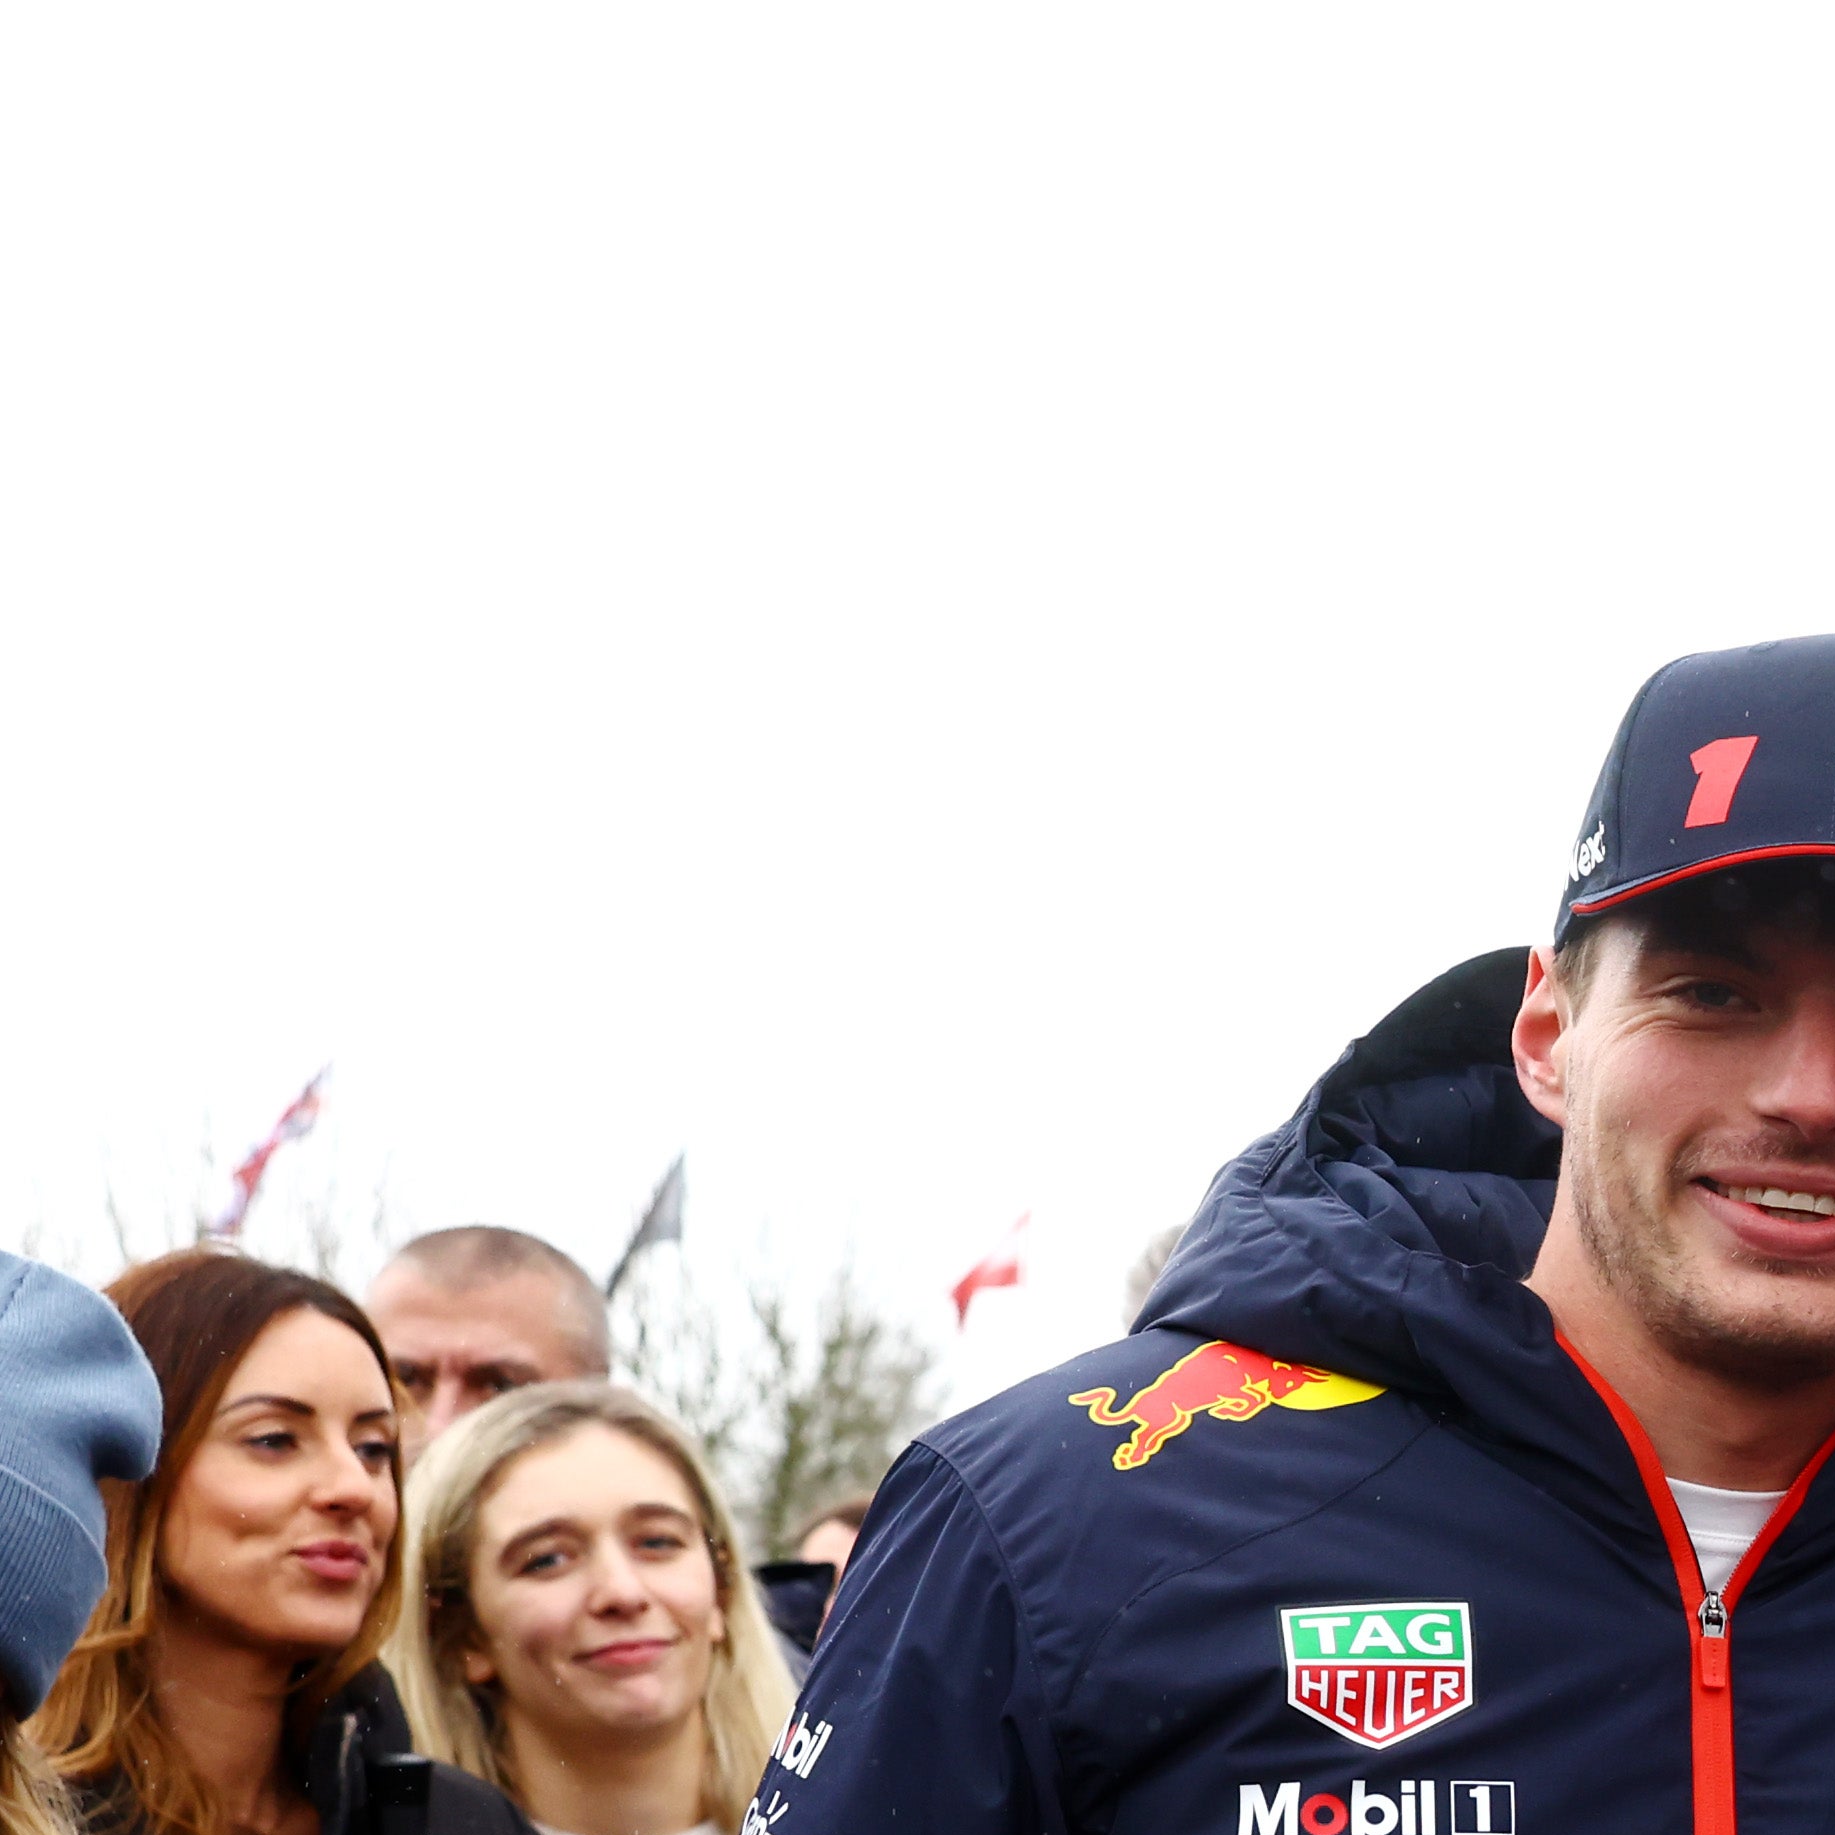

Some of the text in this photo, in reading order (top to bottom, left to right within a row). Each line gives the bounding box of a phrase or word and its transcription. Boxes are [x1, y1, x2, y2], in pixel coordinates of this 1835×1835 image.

[1684, 735, 1759, 828] 1
[1299, 1613, 1454, 1655] TAG
[1301, 1670, 1460, 1739] HEUER
